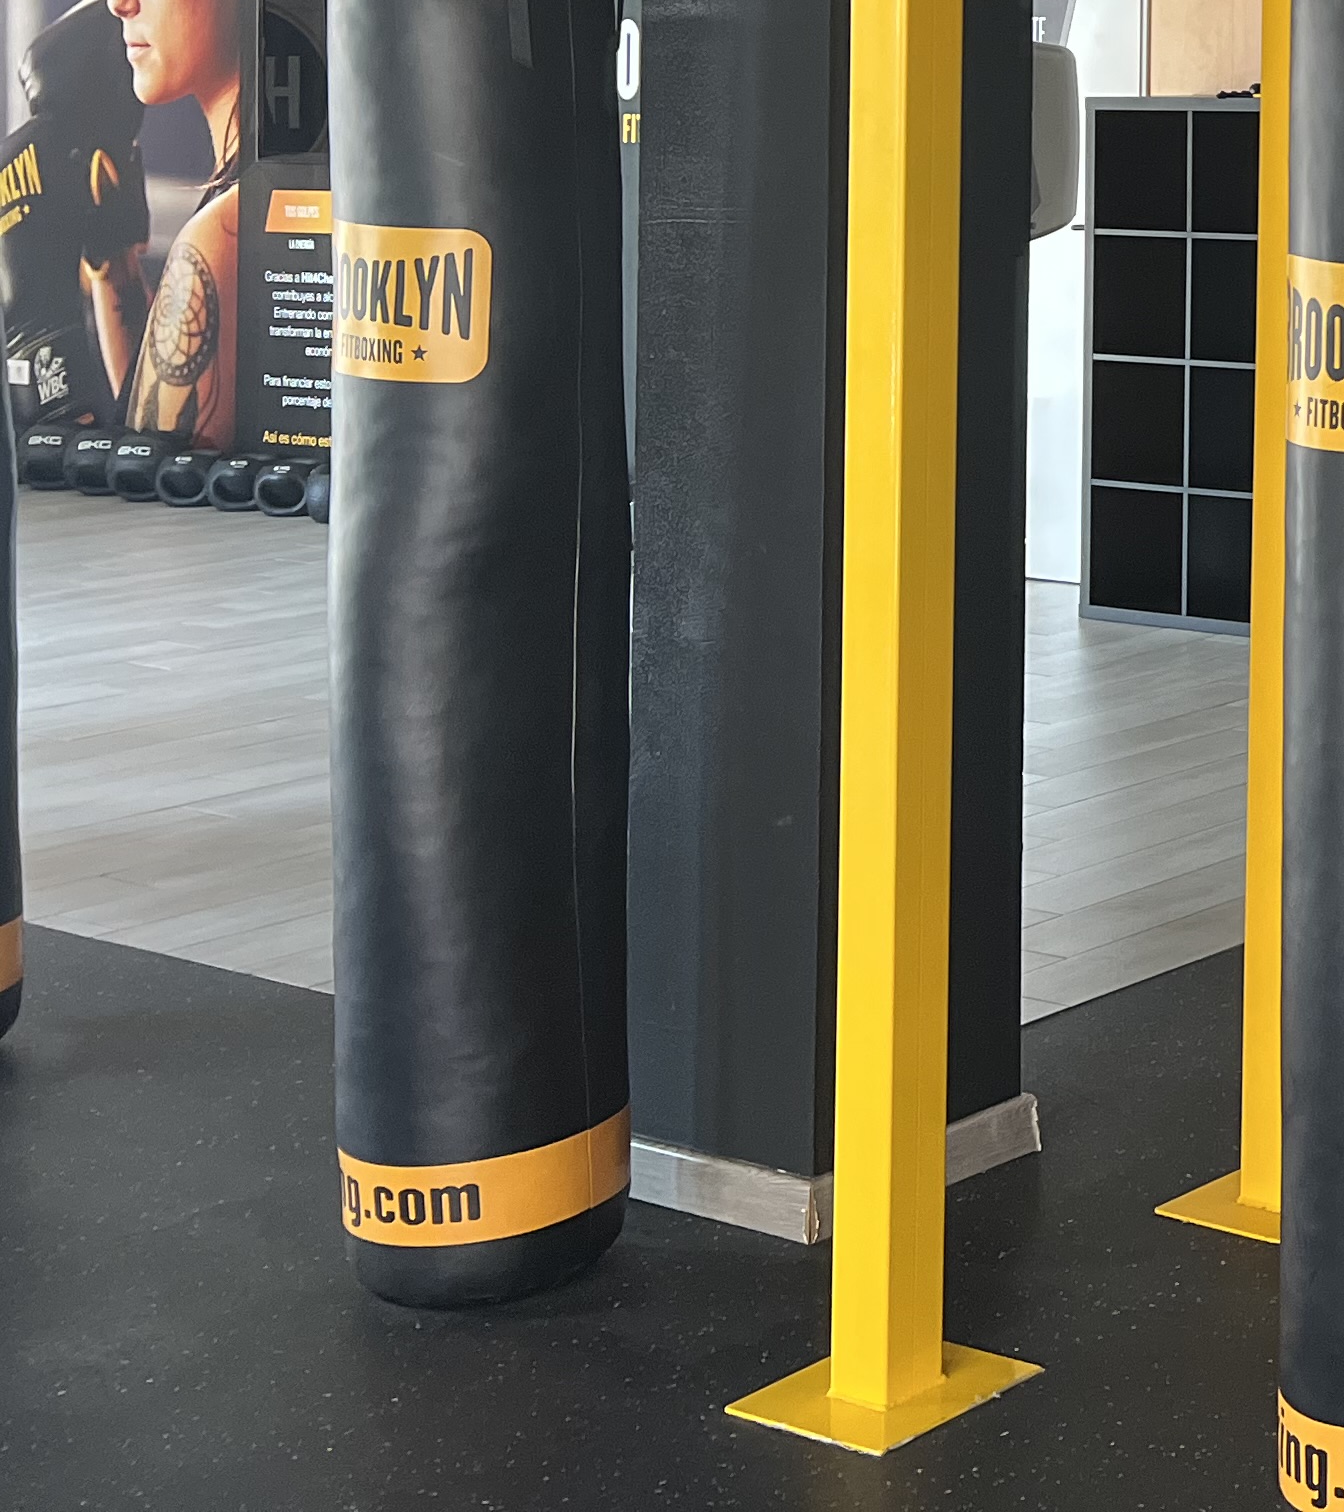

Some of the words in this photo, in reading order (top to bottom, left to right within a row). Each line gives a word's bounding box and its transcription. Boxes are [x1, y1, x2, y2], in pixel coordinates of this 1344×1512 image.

[335, 247, 473, 341] OOKLYN
[315, 327, 322, 339] la
[341, 333, 403, 365] FITBOXING
[263, 374, 281, 387] Para
[278, 434, 290, 445] es
